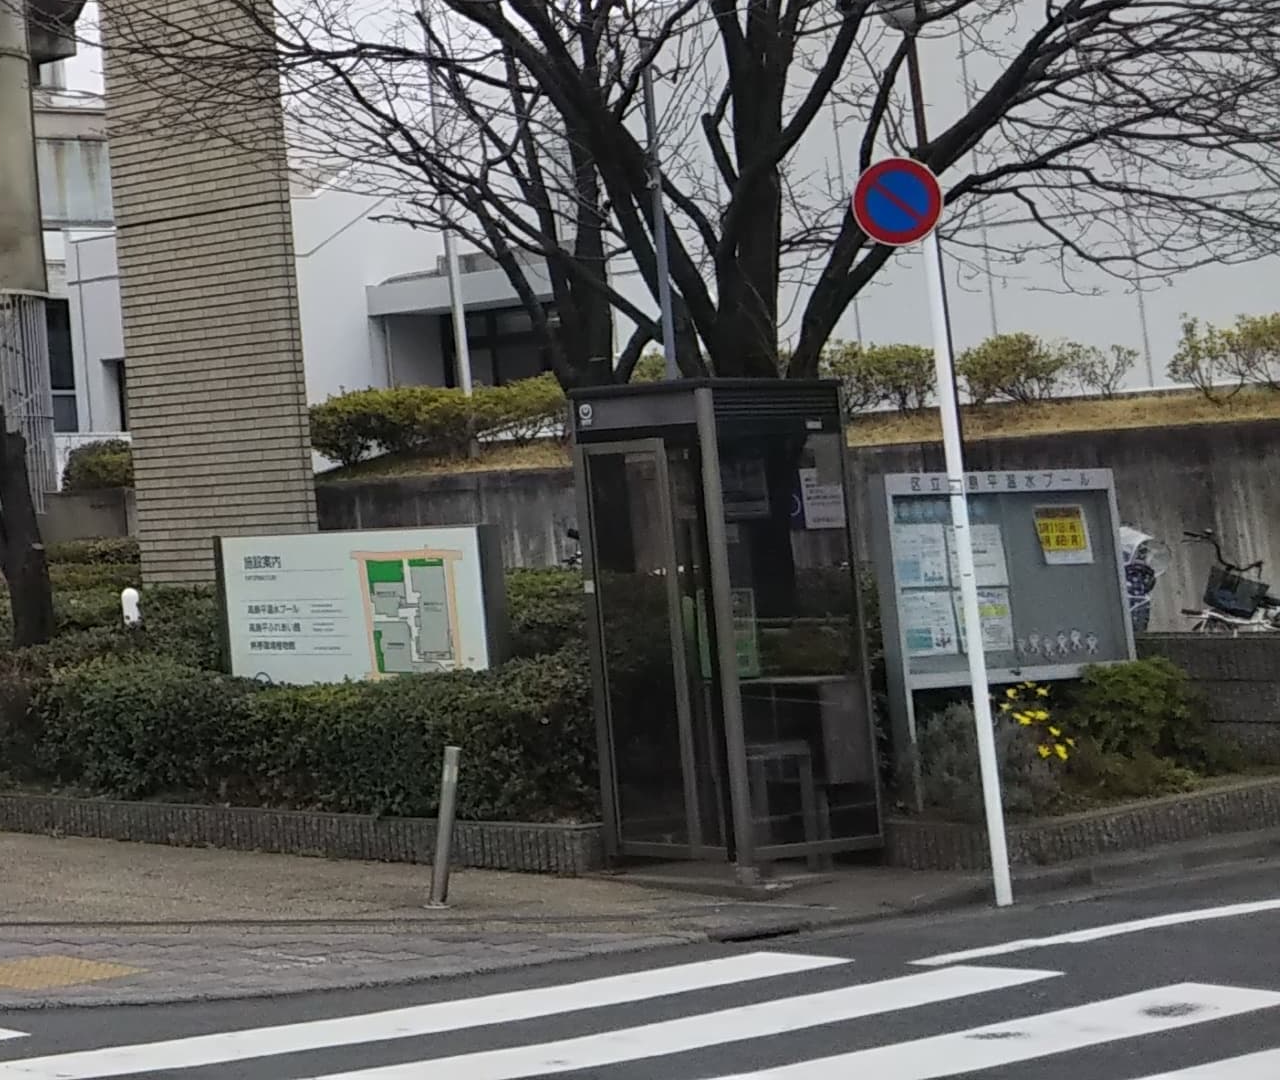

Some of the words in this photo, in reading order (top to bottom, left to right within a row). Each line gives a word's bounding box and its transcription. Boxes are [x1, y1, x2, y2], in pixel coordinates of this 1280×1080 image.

[910, 469, 1091, 492] 区立島平温水プール
